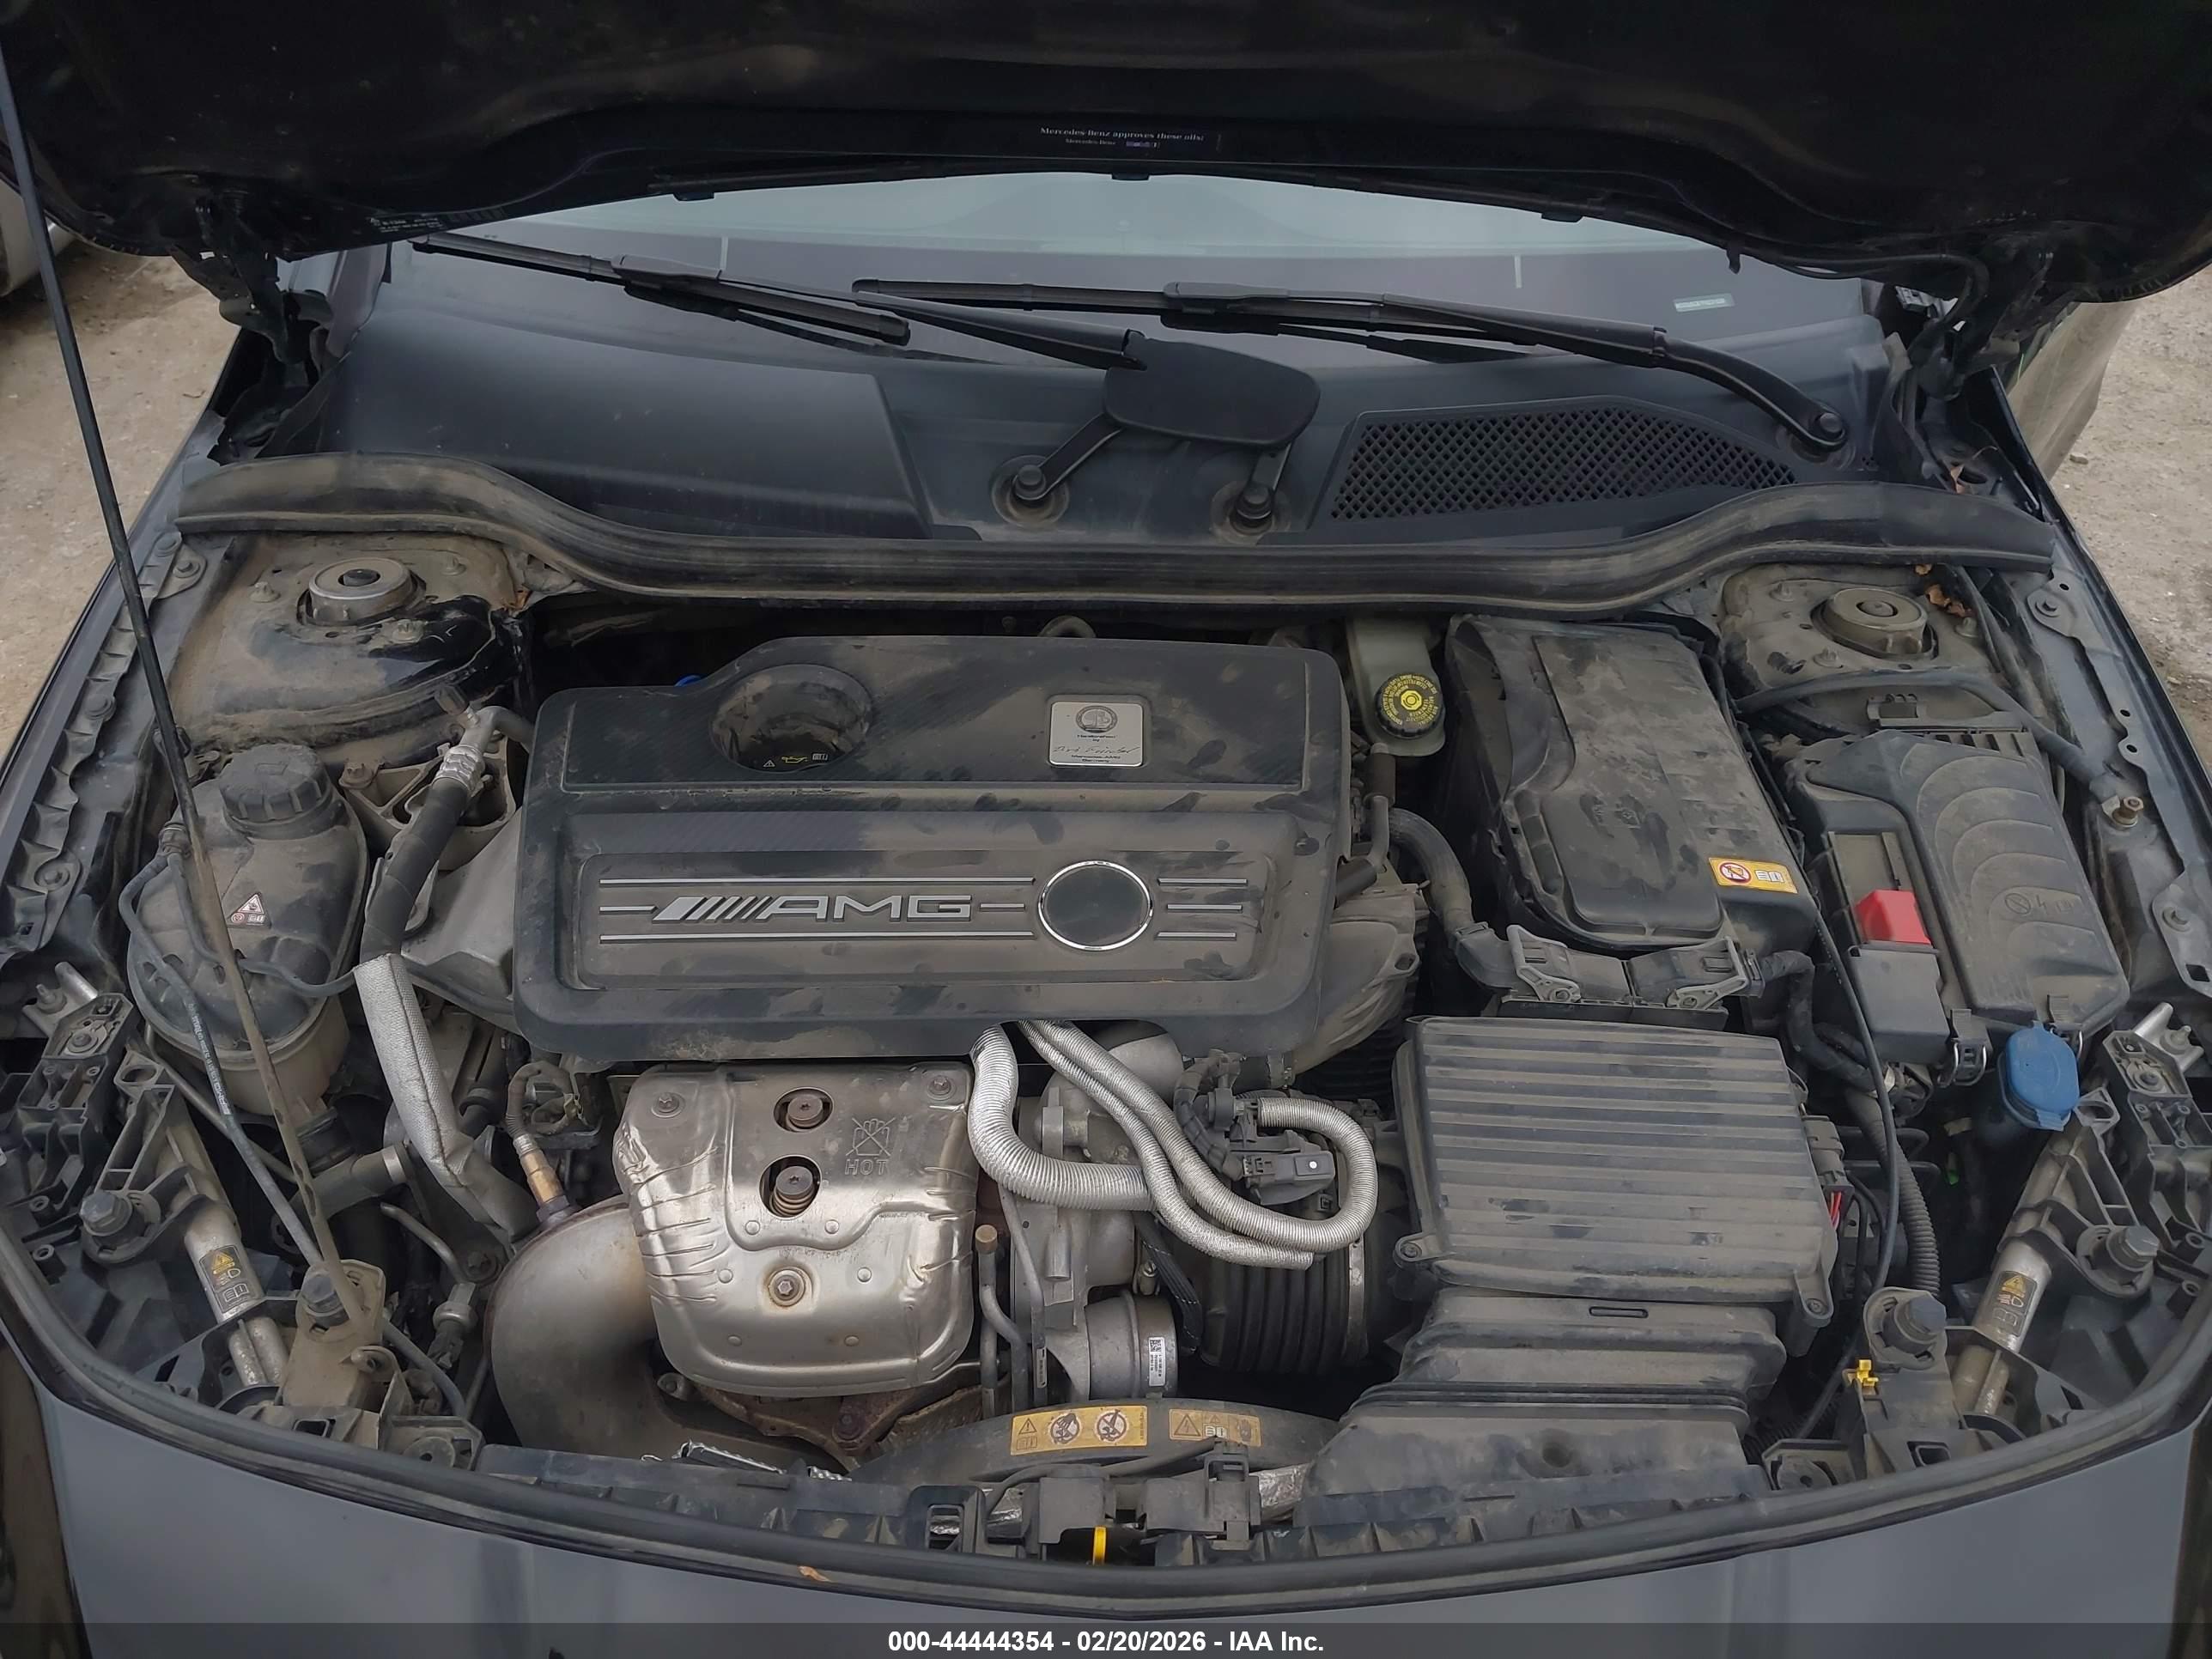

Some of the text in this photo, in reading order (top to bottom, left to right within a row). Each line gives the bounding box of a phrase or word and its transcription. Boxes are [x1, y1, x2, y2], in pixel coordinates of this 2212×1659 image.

[1112, 130, 1154, 139] approves
[1156, 131, 1182, 140] these
[756, 895, 972, 921] AMG
[844, 1158, 889, 1176] HOT
